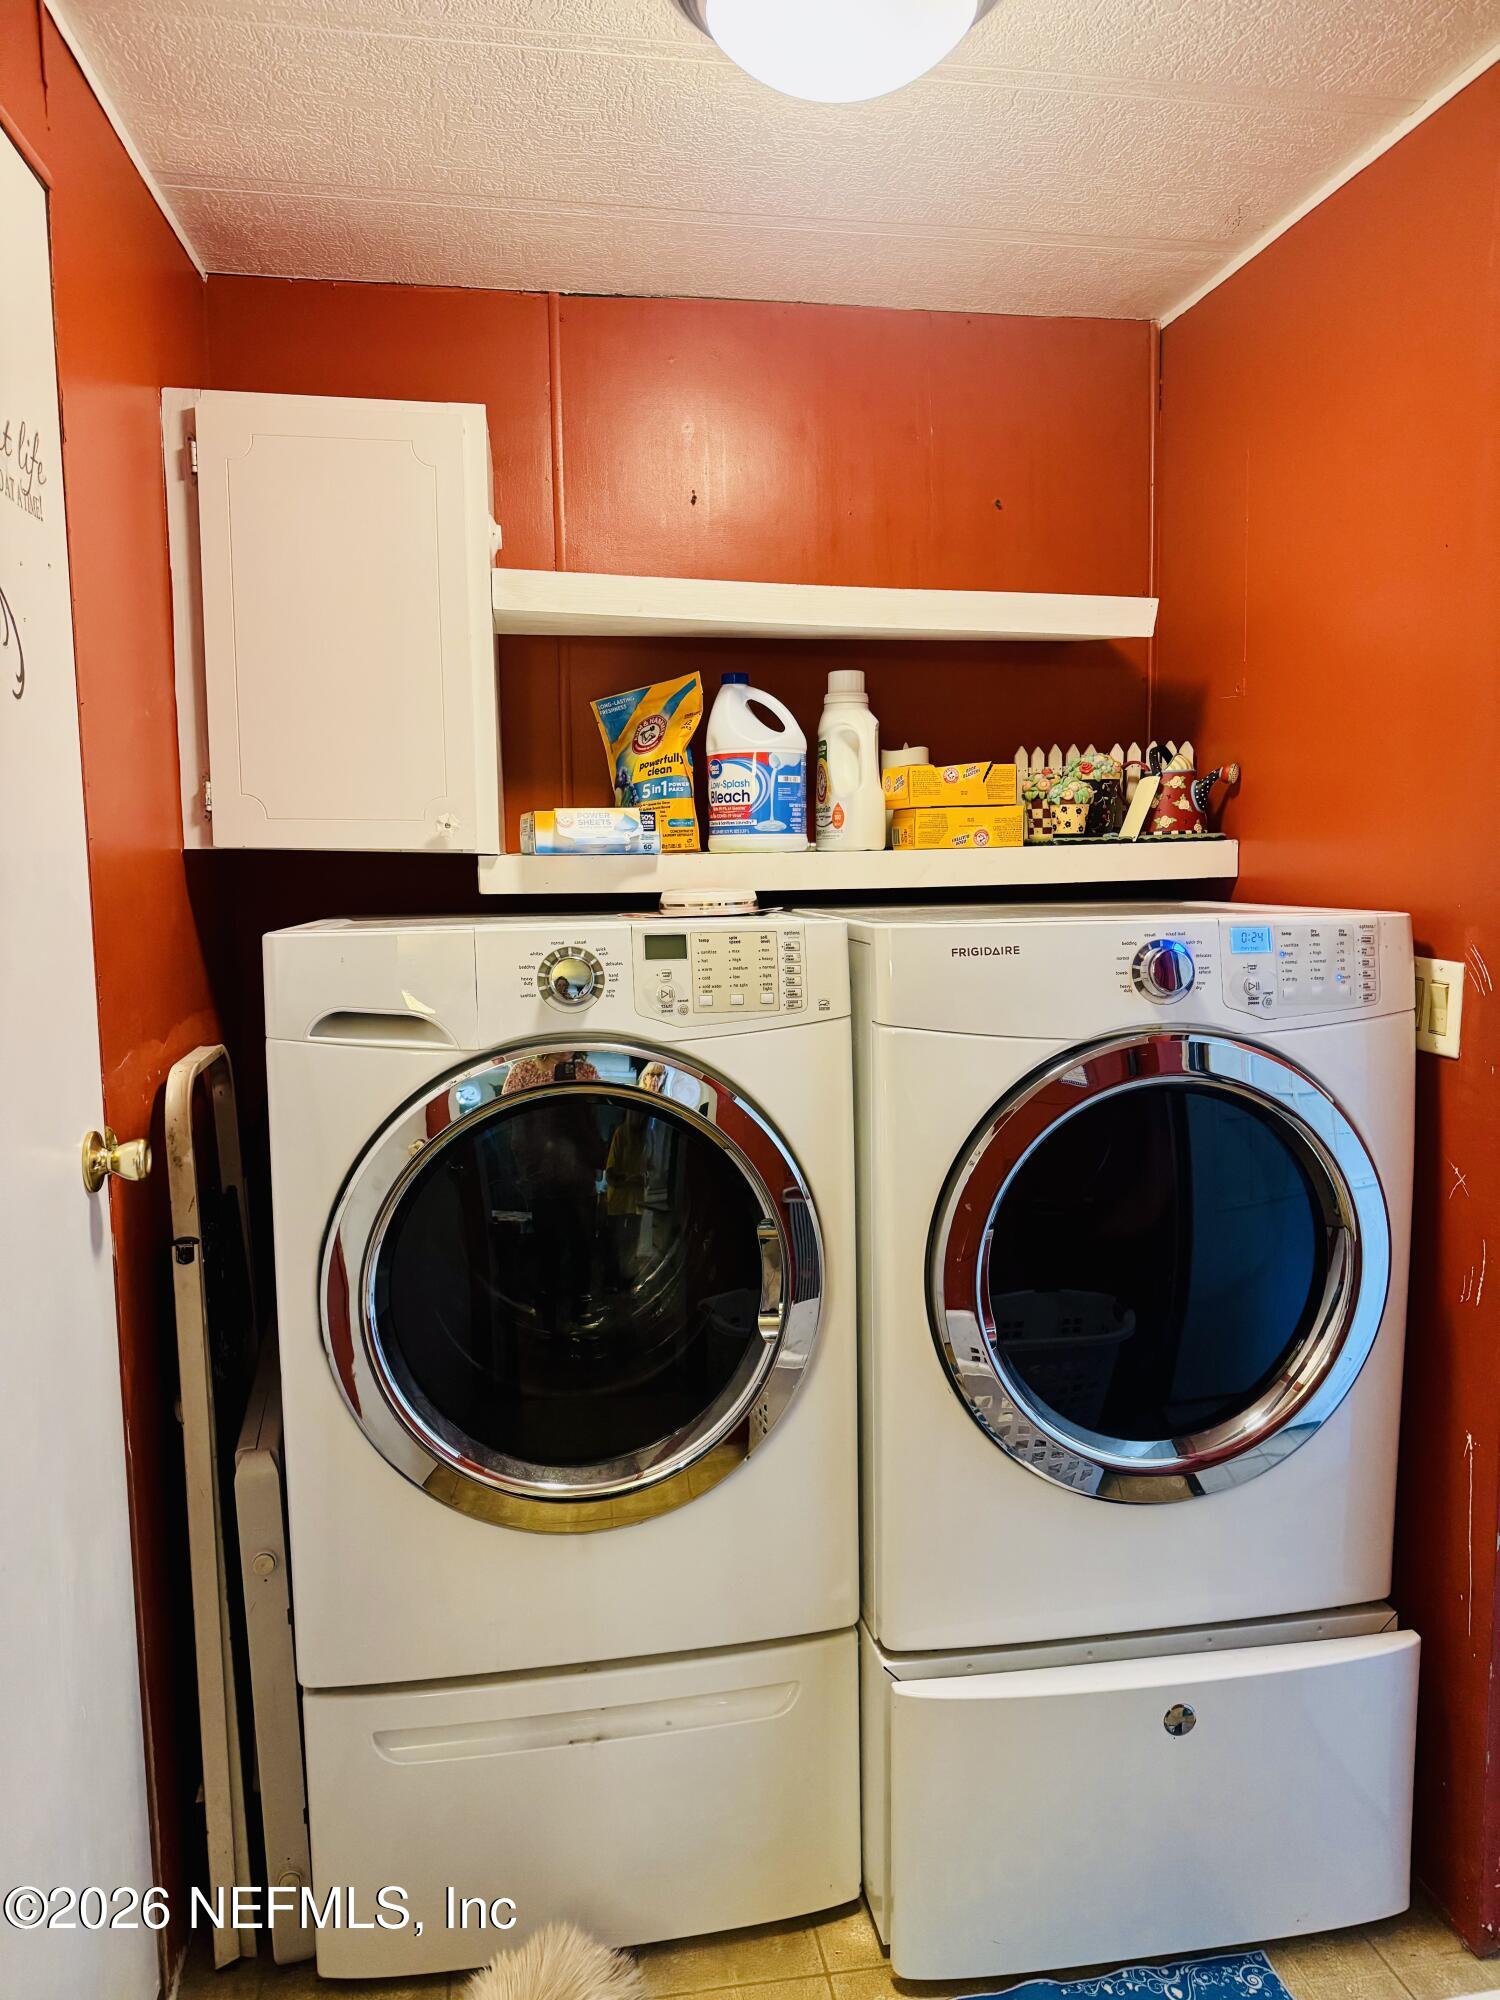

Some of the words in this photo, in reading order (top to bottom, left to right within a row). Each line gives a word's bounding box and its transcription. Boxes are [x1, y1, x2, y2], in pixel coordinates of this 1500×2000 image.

[18, 421, 47, 496] life
[5, 473, 14, 502] AT
[639, 753, 684, 772] powerfully
[647, 766, 672, 776] clean
[710, 779, 750, 789] Low-Splash
[711, 790, 750, 804] Bleach
[1241, 931, 1264, 943] 0:24
[951, 945, 1020, 957] FRIGIDAIRE
